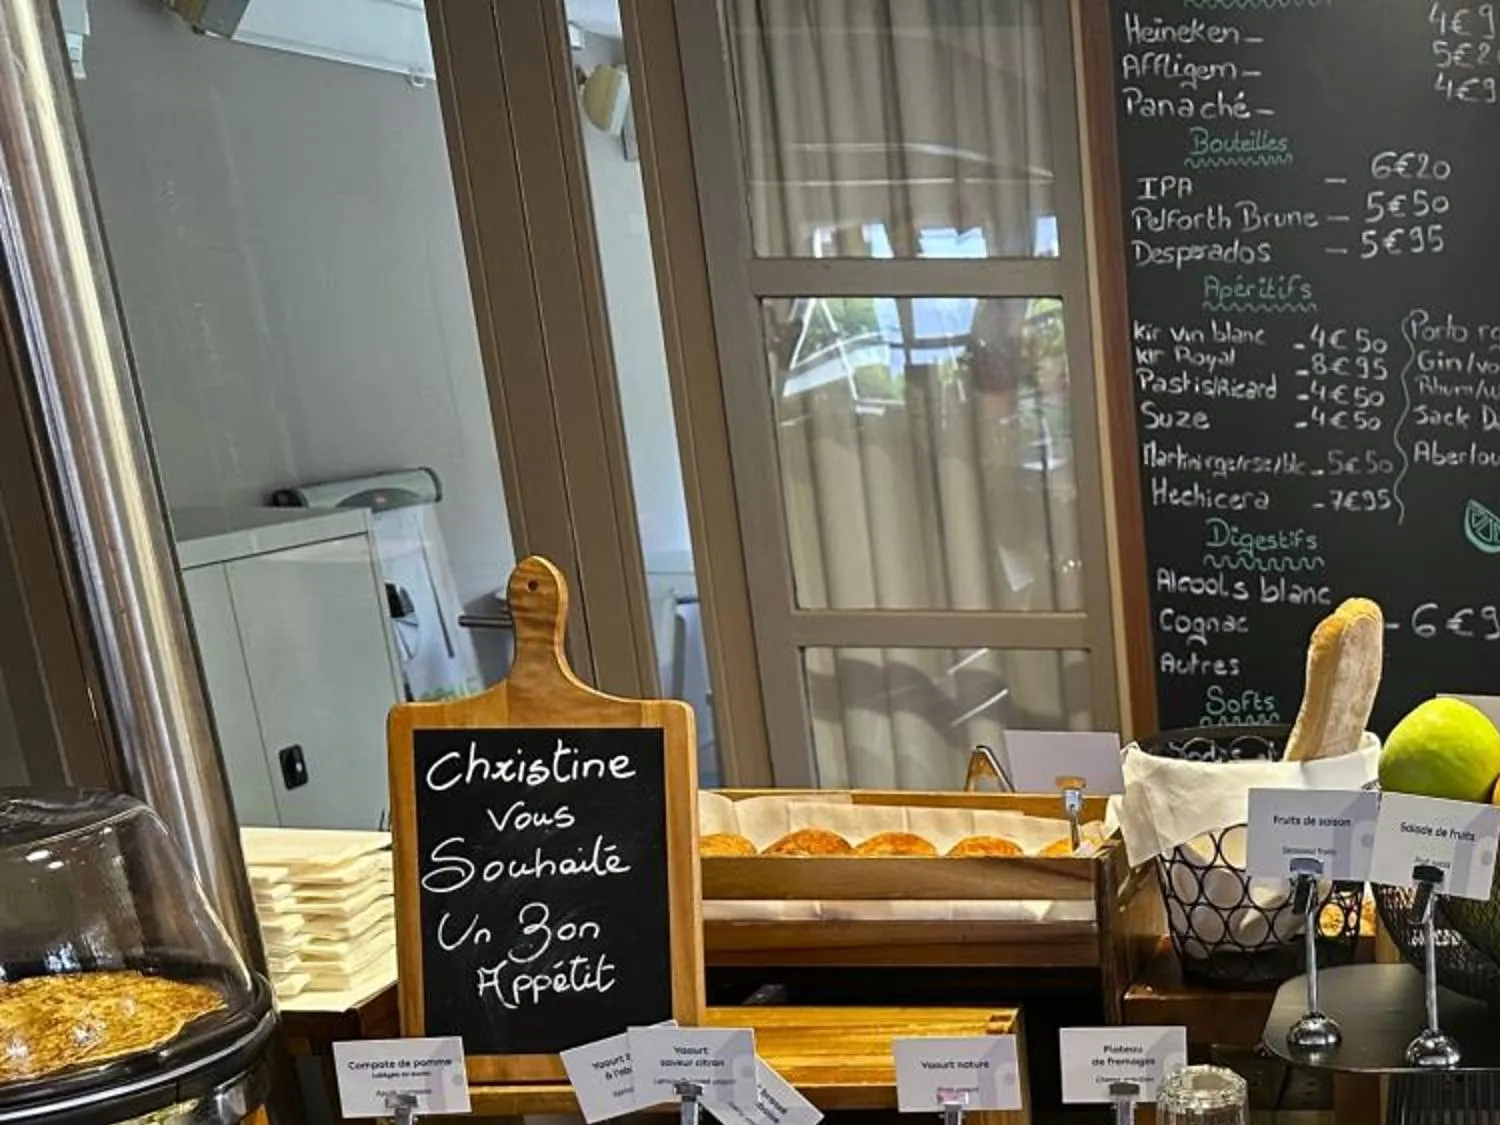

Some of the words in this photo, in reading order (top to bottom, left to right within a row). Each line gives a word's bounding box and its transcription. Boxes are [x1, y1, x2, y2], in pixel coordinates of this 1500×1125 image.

[1124, 12, 1240, 46] Heineken
[1122, 52, 1237, 90] Affligem
[1189, 126, 1290, 155] Bouteilles
[1136, 175, 1194, 200] IPA
[1131, 204, 1232, 233] Pelforth
[1234, 200, 1319, 232] Brune
[1131, 238, 1272, 271] Desperados
[1211, 319, 1267, 345] blanc
[1174, 347, 1236, 374] Royal
[1140, 401, 1211, 430] Suze
[1205, 517, 1318, 557] Digestifs
[1260, 575, 1332, 605] blanc
[1159, 608, 1249, 646] Cognac
[1160, 652, 1241, 677] Autres
[1205, 685, 1275, 716] Softs
[426, 739, 638, 791] Christine
[1273, 814, 1301, 827] Fruits
[1303, 815, 1317, 826] de
[1435, 825, 1448, 838] de
[437, 912, 492, 951] Un
